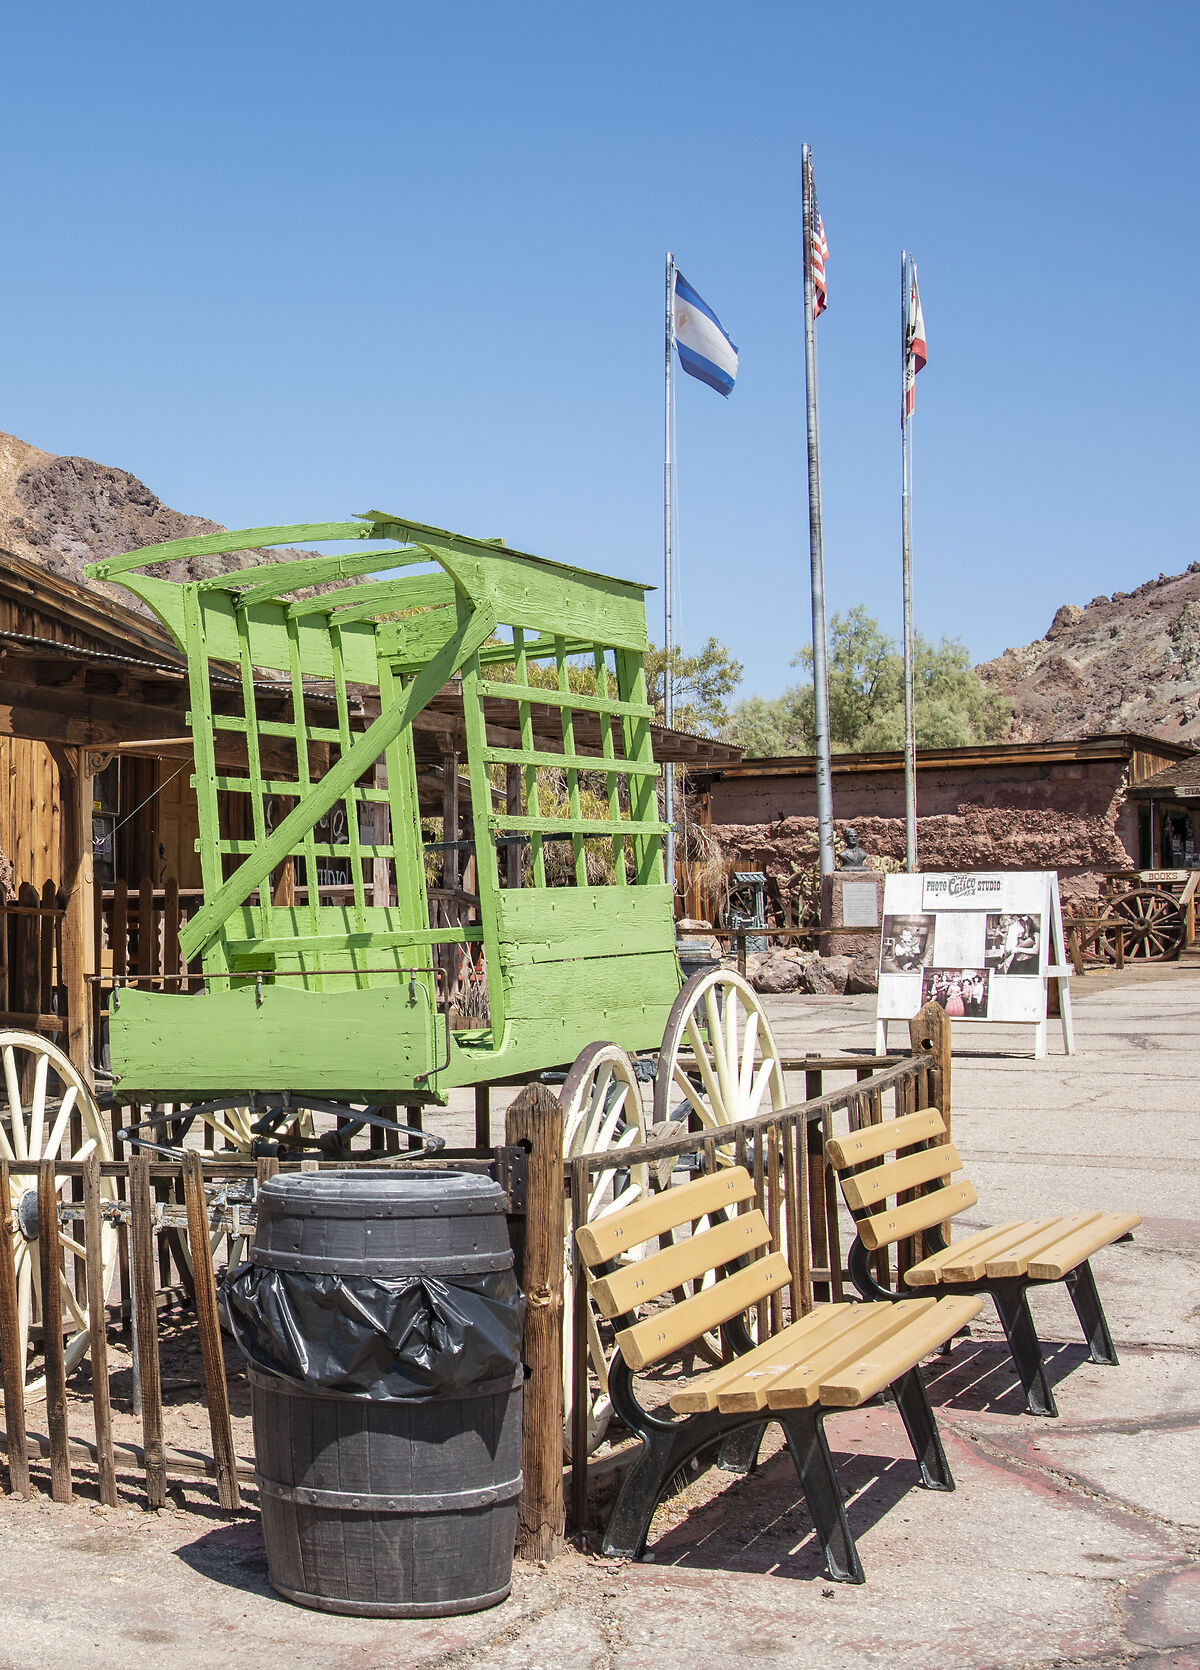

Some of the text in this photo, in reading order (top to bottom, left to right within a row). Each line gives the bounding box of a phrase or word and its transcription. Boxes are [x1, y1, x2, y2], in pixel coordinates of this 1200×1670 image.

[1148, 872, 1178, 881] BOOKS
[926, 880, 947, 892] PHOTO
[977, 880, 1001, 892] STUDIO
